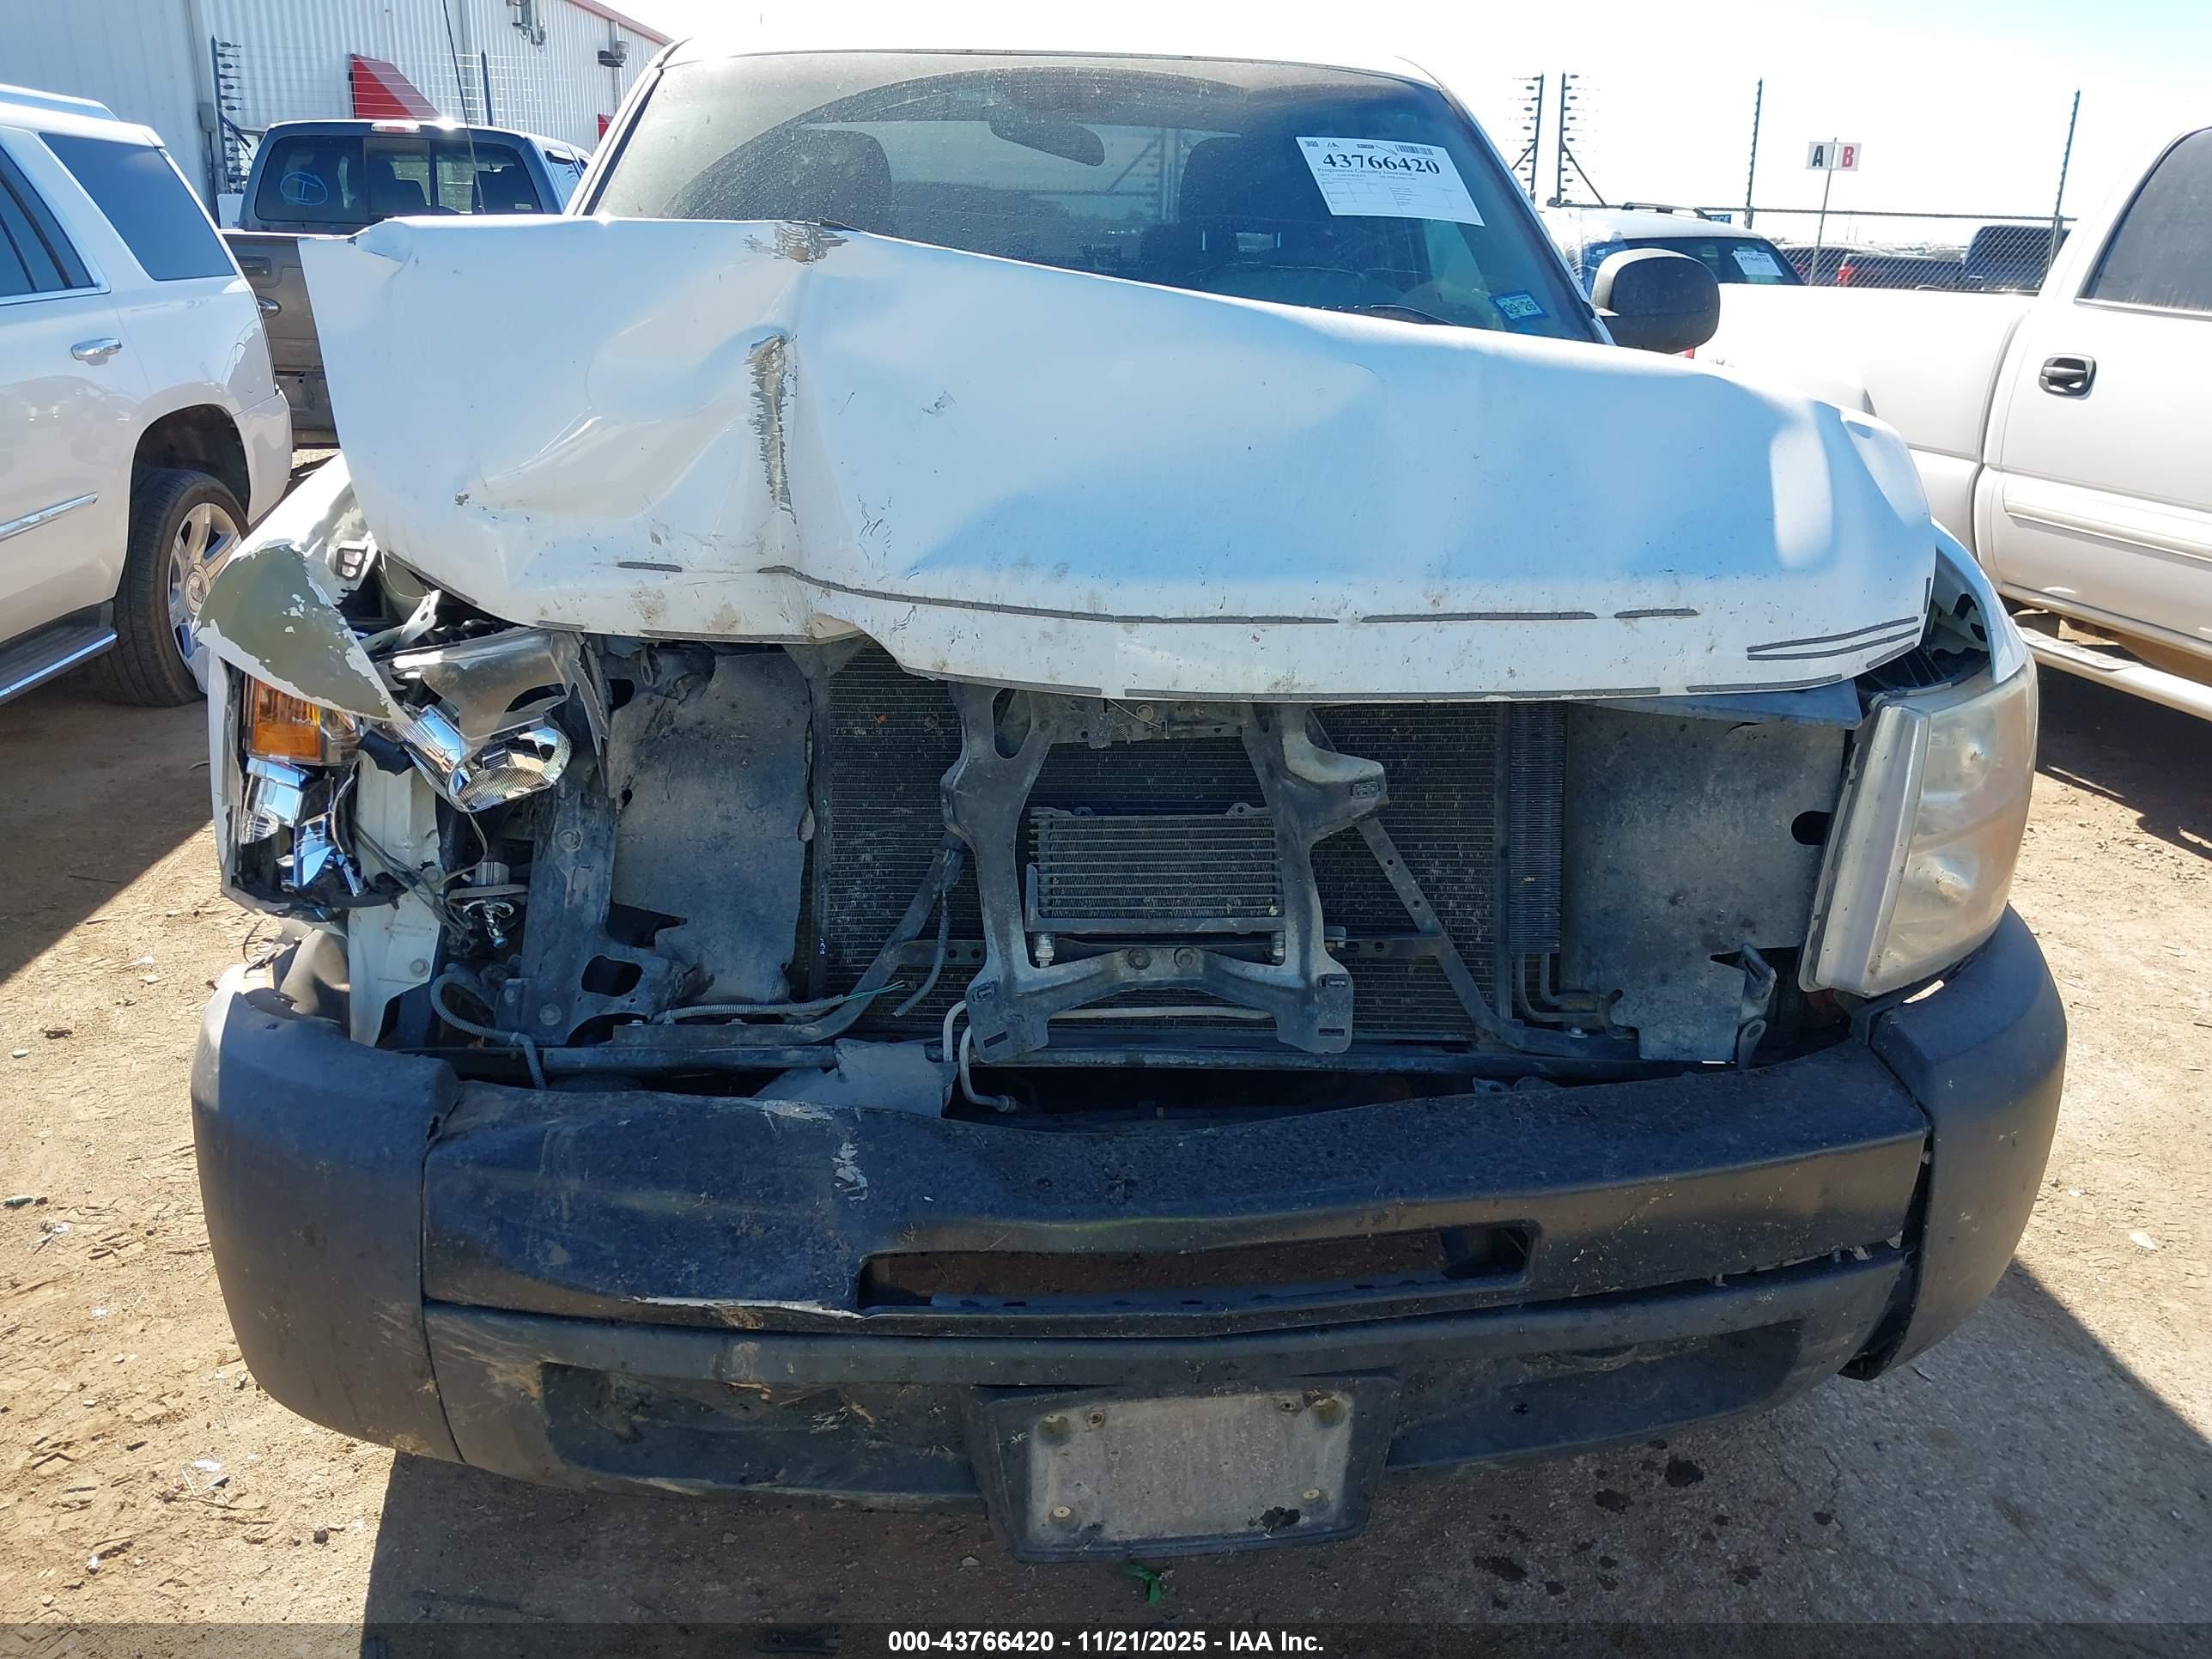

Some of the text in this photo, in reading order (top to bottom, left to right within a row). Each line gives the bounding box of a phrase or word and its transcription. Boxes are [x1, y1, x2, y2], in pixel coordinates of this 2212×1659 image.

[1322, 154, 1440, 174] 43766420
[1812, 145, 1824, 167] A
[1841, 146, 1855, 167] B
